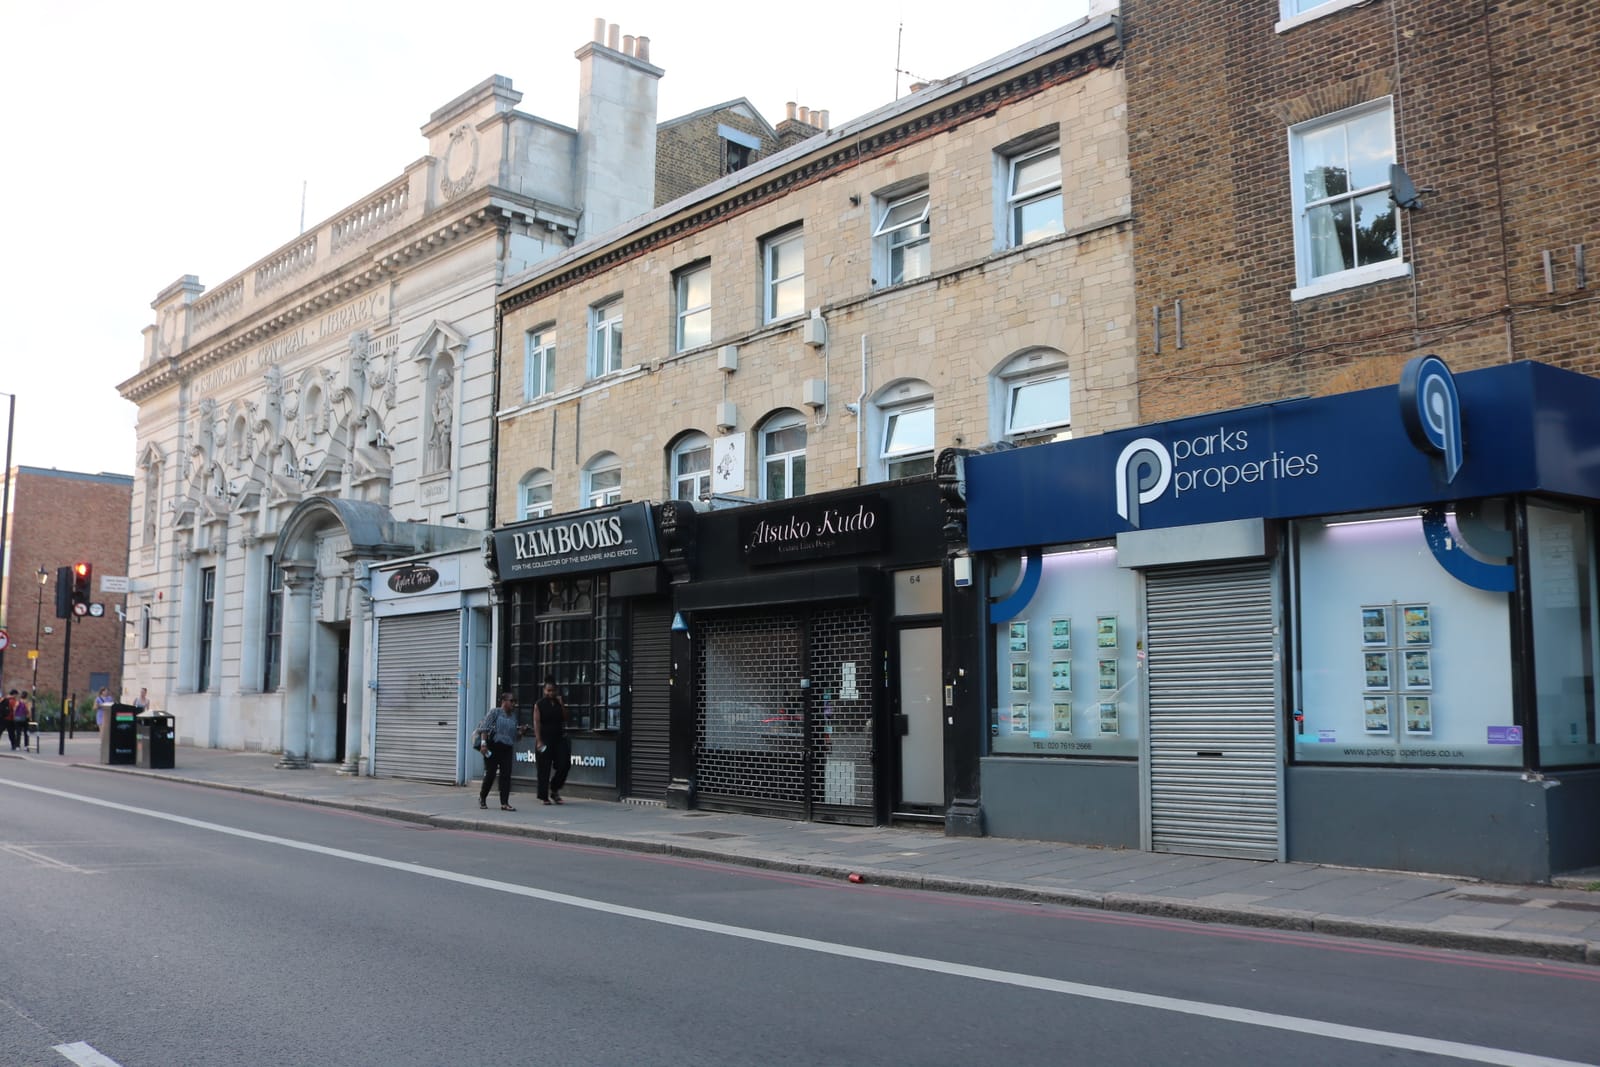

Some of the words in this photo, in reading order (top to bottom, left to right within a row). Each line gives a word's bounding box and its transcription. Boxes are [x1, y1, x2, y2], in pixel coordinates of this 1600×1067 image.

[319, 292, 378, 337] LIBRARY
[1172, 427, 1248, 467] parks
[1174, 450, 1319, 498] properties
[744, 515, 811, 552] Atsuko
[816, 504, 875, 536] Kudo
[532, 560, 561, 569] COLLECTOR
[580, 552, 603, 562] BIZARRE
[603, 551, 616, 559] AND
[617, 548, 638, 556] EROTIC
[909, 575, 921, 584] 64
[1343, 747, 1465, 759] www.parkspoperties.co.uk
